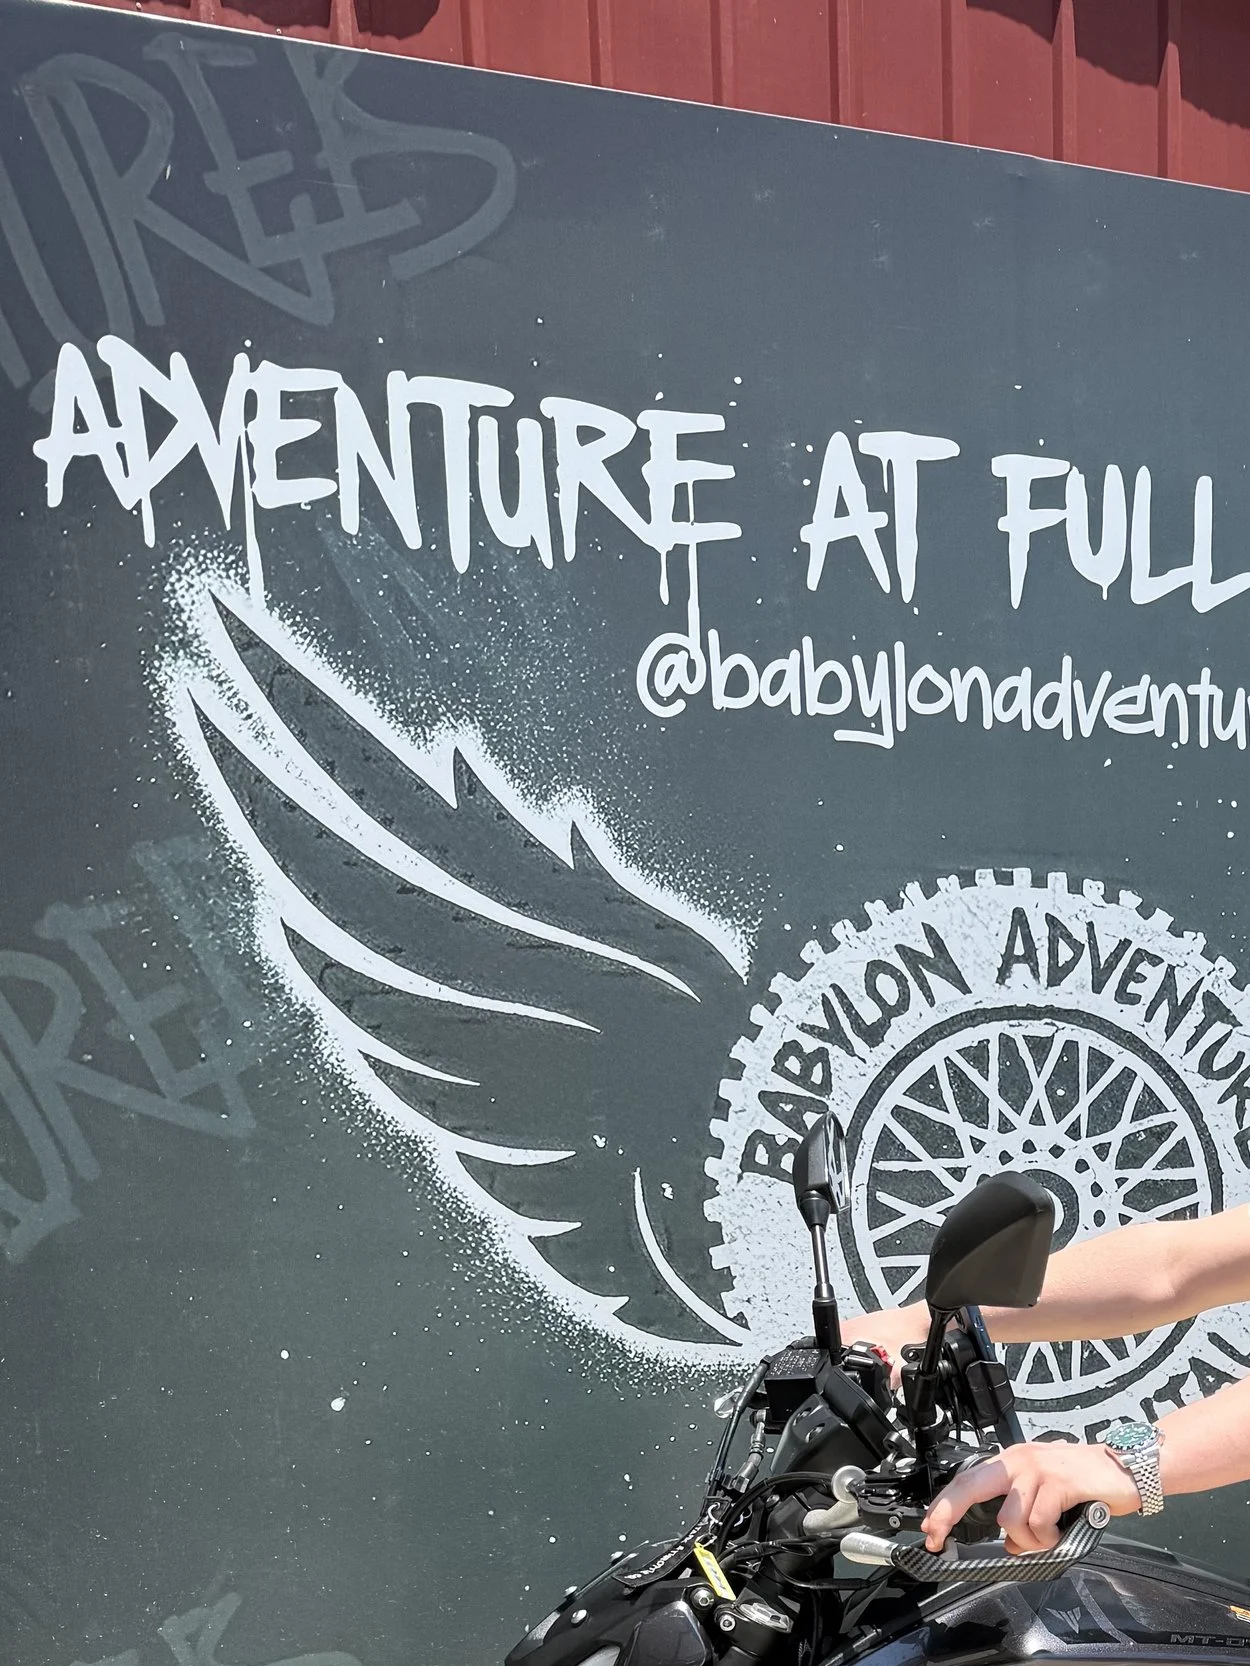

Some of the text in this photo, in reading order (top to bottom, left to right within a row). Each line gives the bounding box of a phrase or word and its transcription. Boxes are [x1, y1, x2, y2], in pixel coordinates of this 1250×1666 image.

[34, 335, 742, 600] ADVENTURE
[800, 431, 960, 604] AT
[740, 921, 972, 1182] BABYLON
